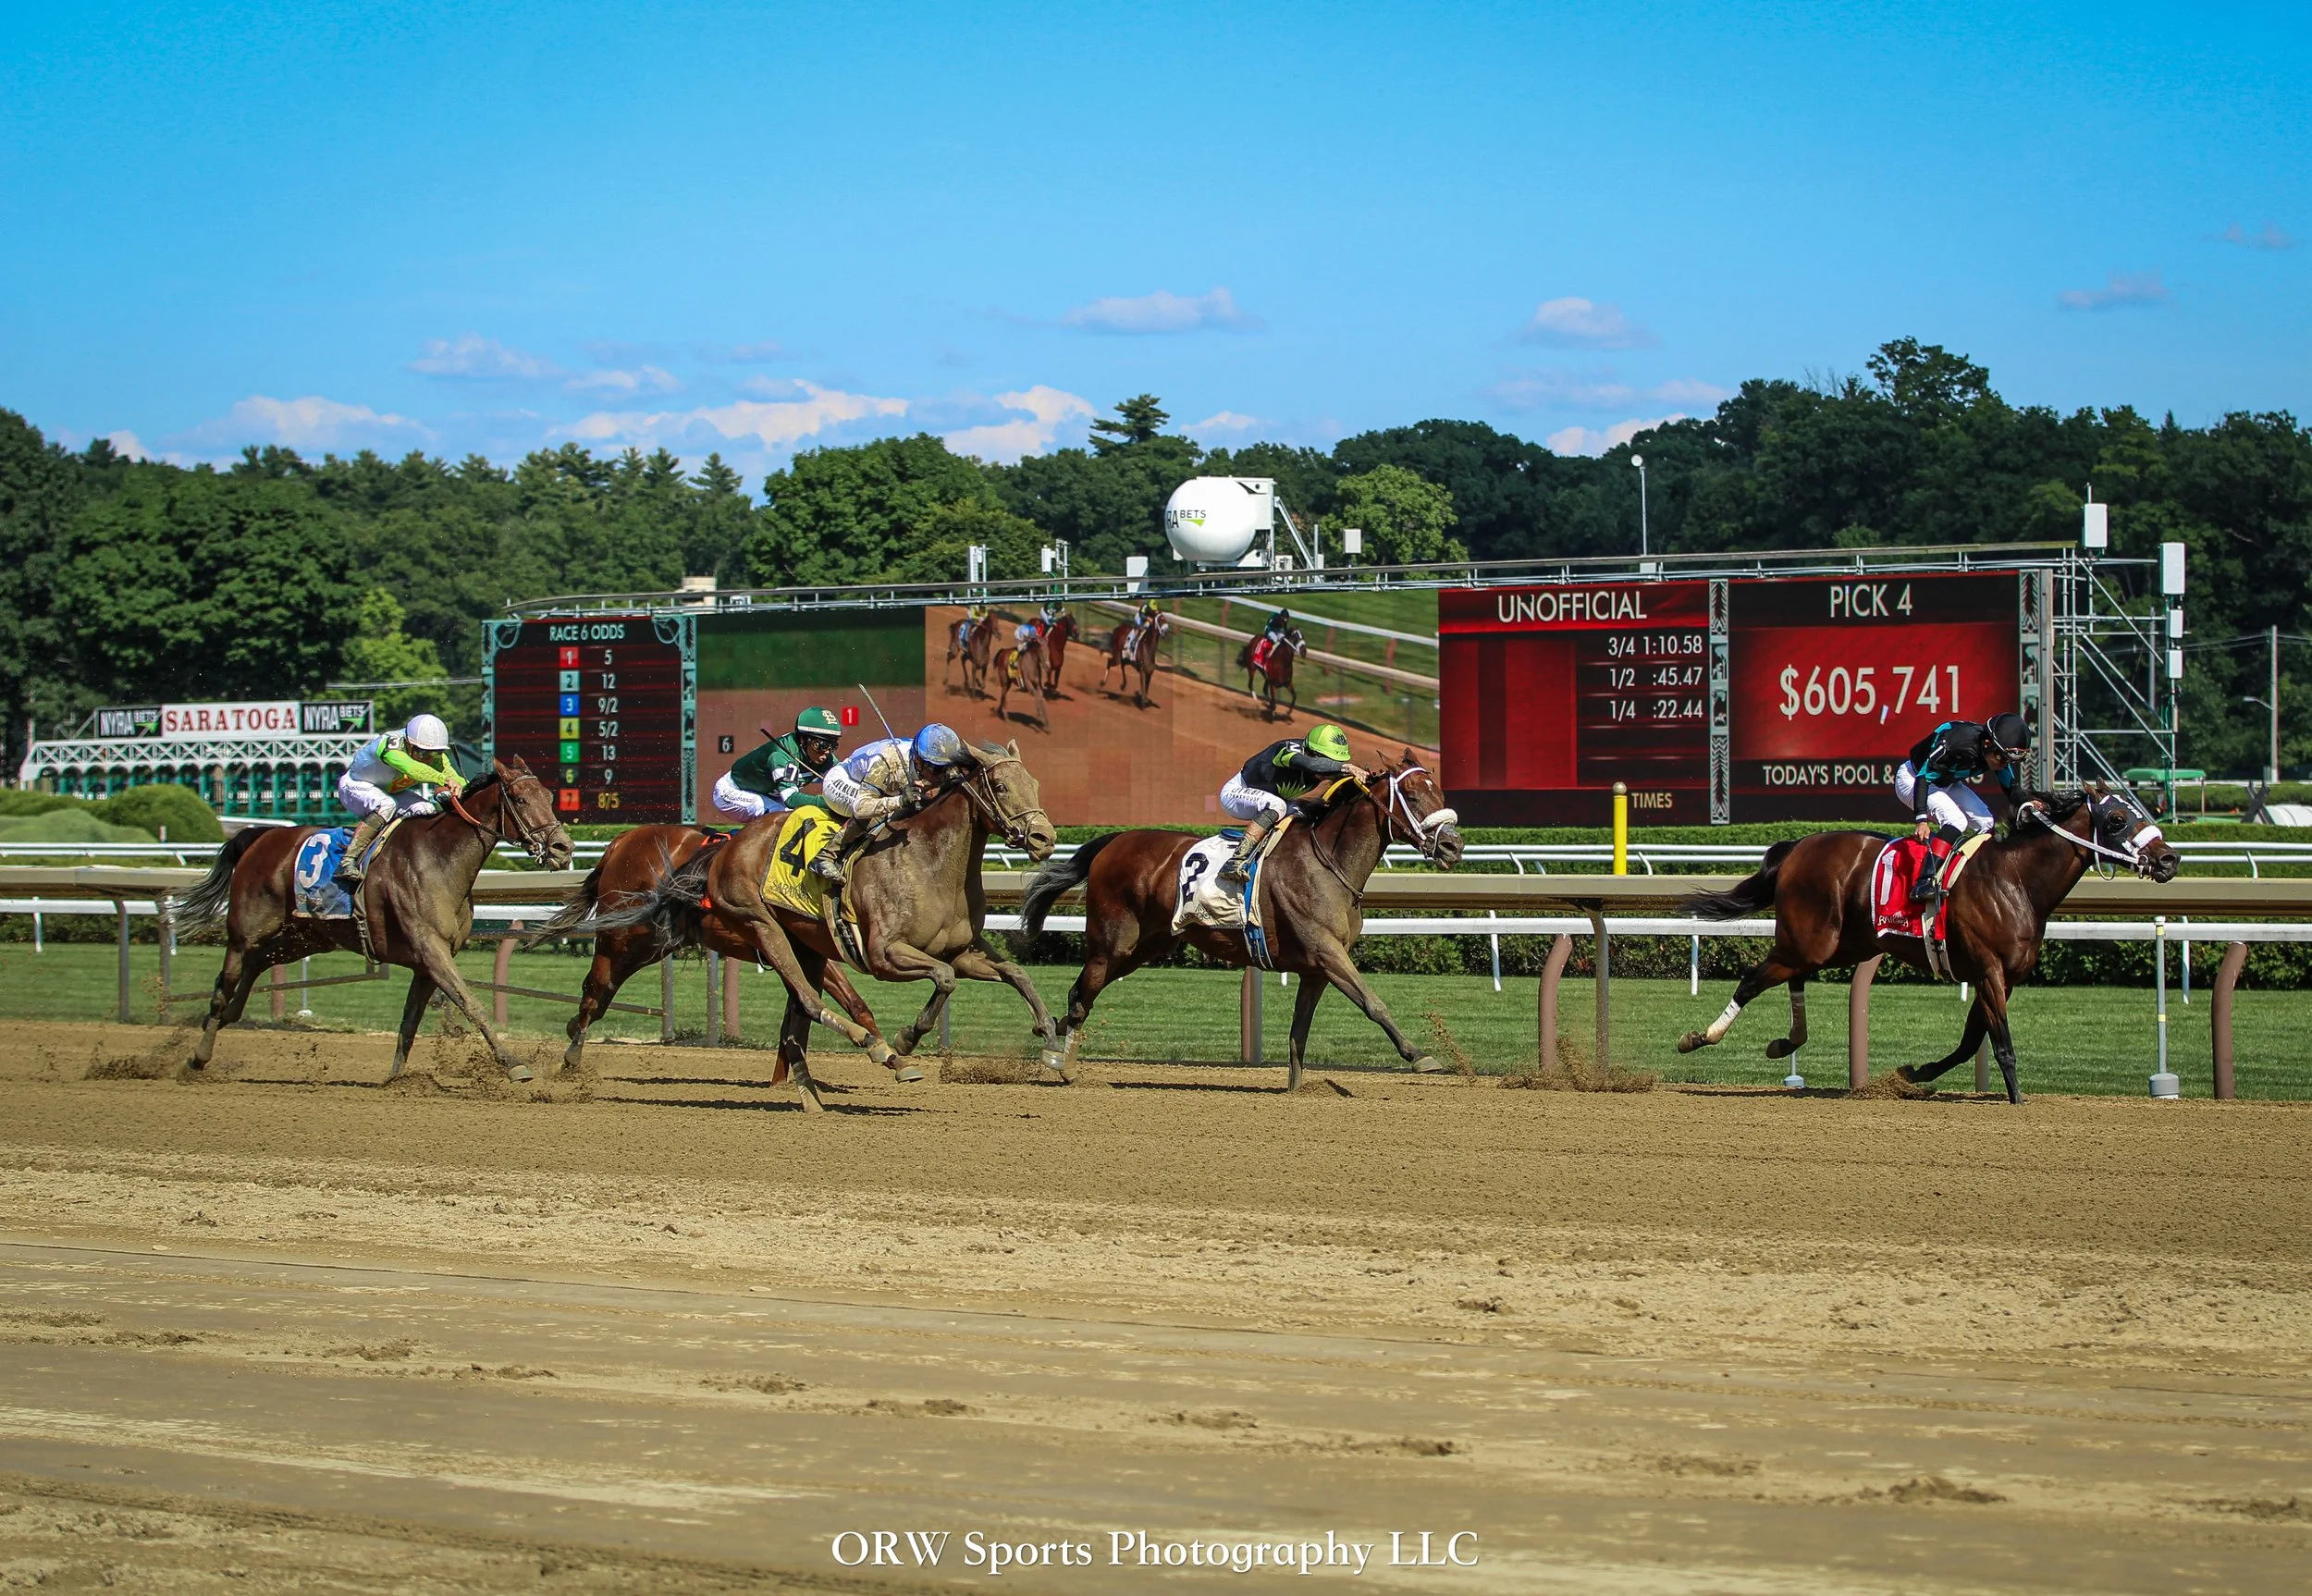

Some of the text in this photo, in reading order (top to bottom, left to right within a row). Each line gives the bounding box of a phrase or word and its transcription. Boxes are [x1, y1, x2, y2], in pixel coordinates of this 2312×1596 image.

[1180, 510, 1207, 519] BETS
[1497, 591, 1647, 623] UNOFFICIAL
[1829, 583, 1912, 618] PICK 4
[549, 624, 625, 642] RACE 6 ODDS
[1608, 635, 1703, 658] 3/4 1:10.58
[565, 649, 613, 665] 1 5
[565, 673, 616, 690] 2 12
[1609, 667, 1703, 689] 1/2 :45.47
[1779, 664, 1959, 725] $605,741
[565, 697, 619, 715] 3 9/2
[1609, 699, 1703, 721] 1/4 :22.44
[100, 708, 157, 737] NYRA BETS
[165, 707, 297, 732] SARATOGA
[303, 703, 364, 731] NYRA BETS
[846, 708, 854, 724] 1
[564, 721, 619, 739] 4 5/2
[387, 736, 400, 749] 3
[722, 736, 731, 753] 6
[565, 744, 617, 761] 5 13
[565, 768, 613, 785] 6 9
[787, 763, 798, 781] 7
[1763, 764, 1895, 785] TODAY'S POOL &
[566, 792, 621, 810] 7 8/5
[1631, 792, 1673, 809] TIMES
[780, 817, 818, 878] 4
[298, 833, 331, 889] 3
[1182, 853, 1209, 903] 2
[1880, 849, 1897, 905] 1
